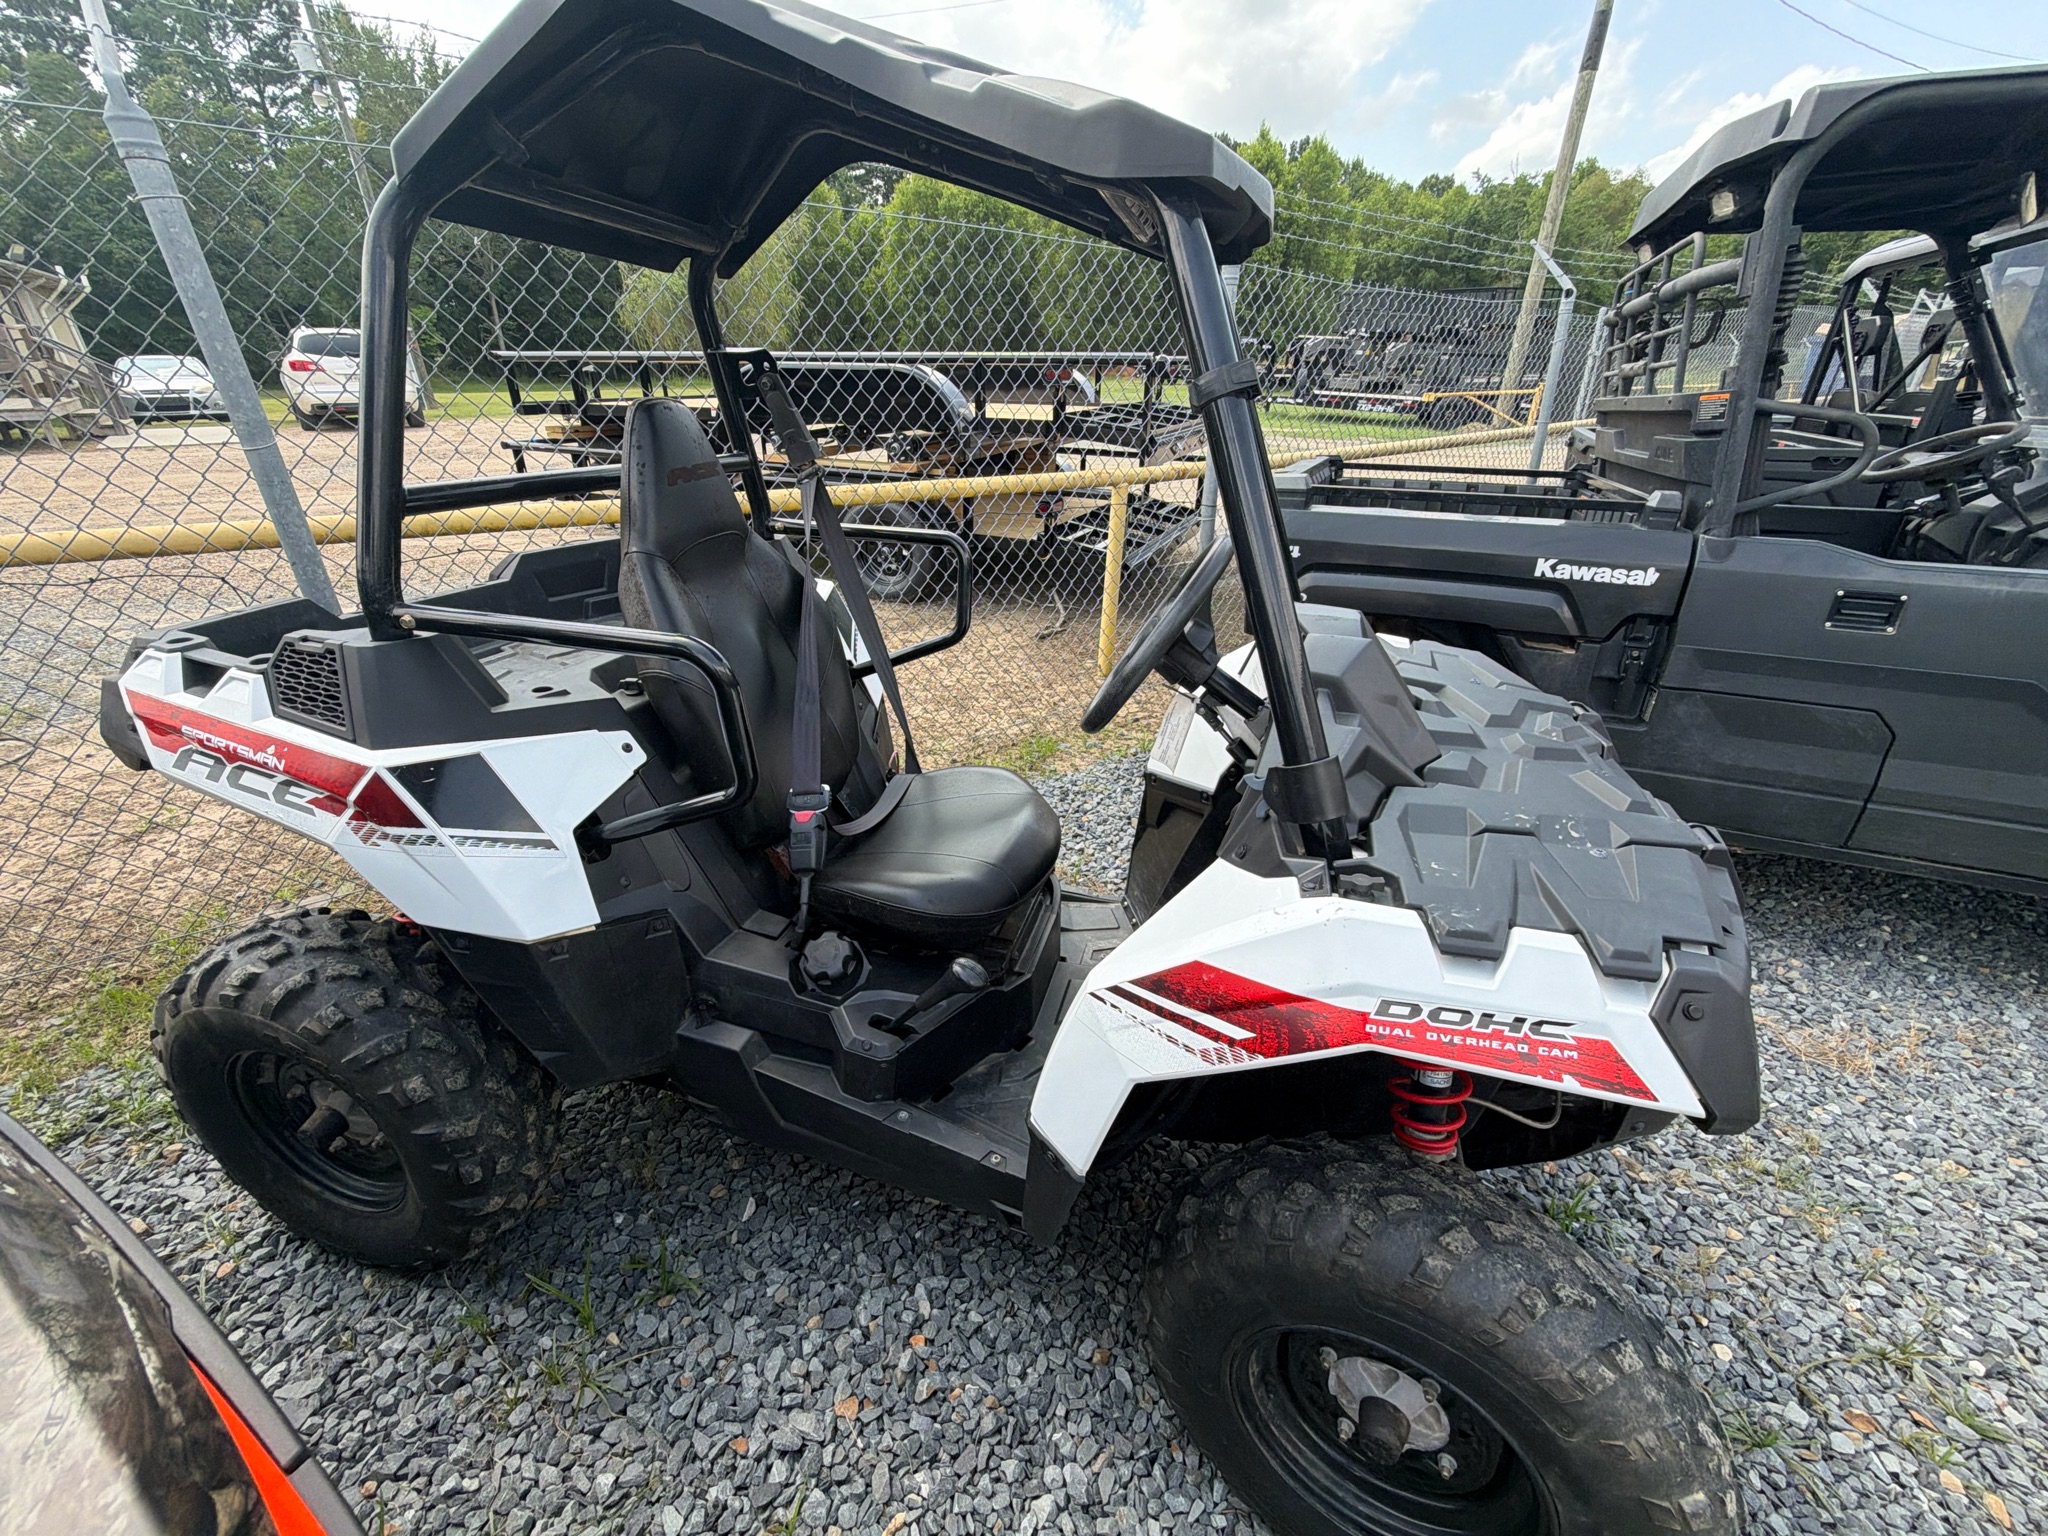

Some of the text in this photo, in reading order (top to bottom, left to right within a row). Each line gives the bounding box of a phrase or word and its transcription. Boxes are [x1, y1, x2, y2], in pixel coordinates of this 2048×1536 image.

[181, 725, 286, 772] SPORTSMAN
[172, 746, 326, 817] ACE
[1365, 1024, 1578, 1059] DUAL OVERHEAD CAM
[1374, 999, 1579, 1041] DOHC
